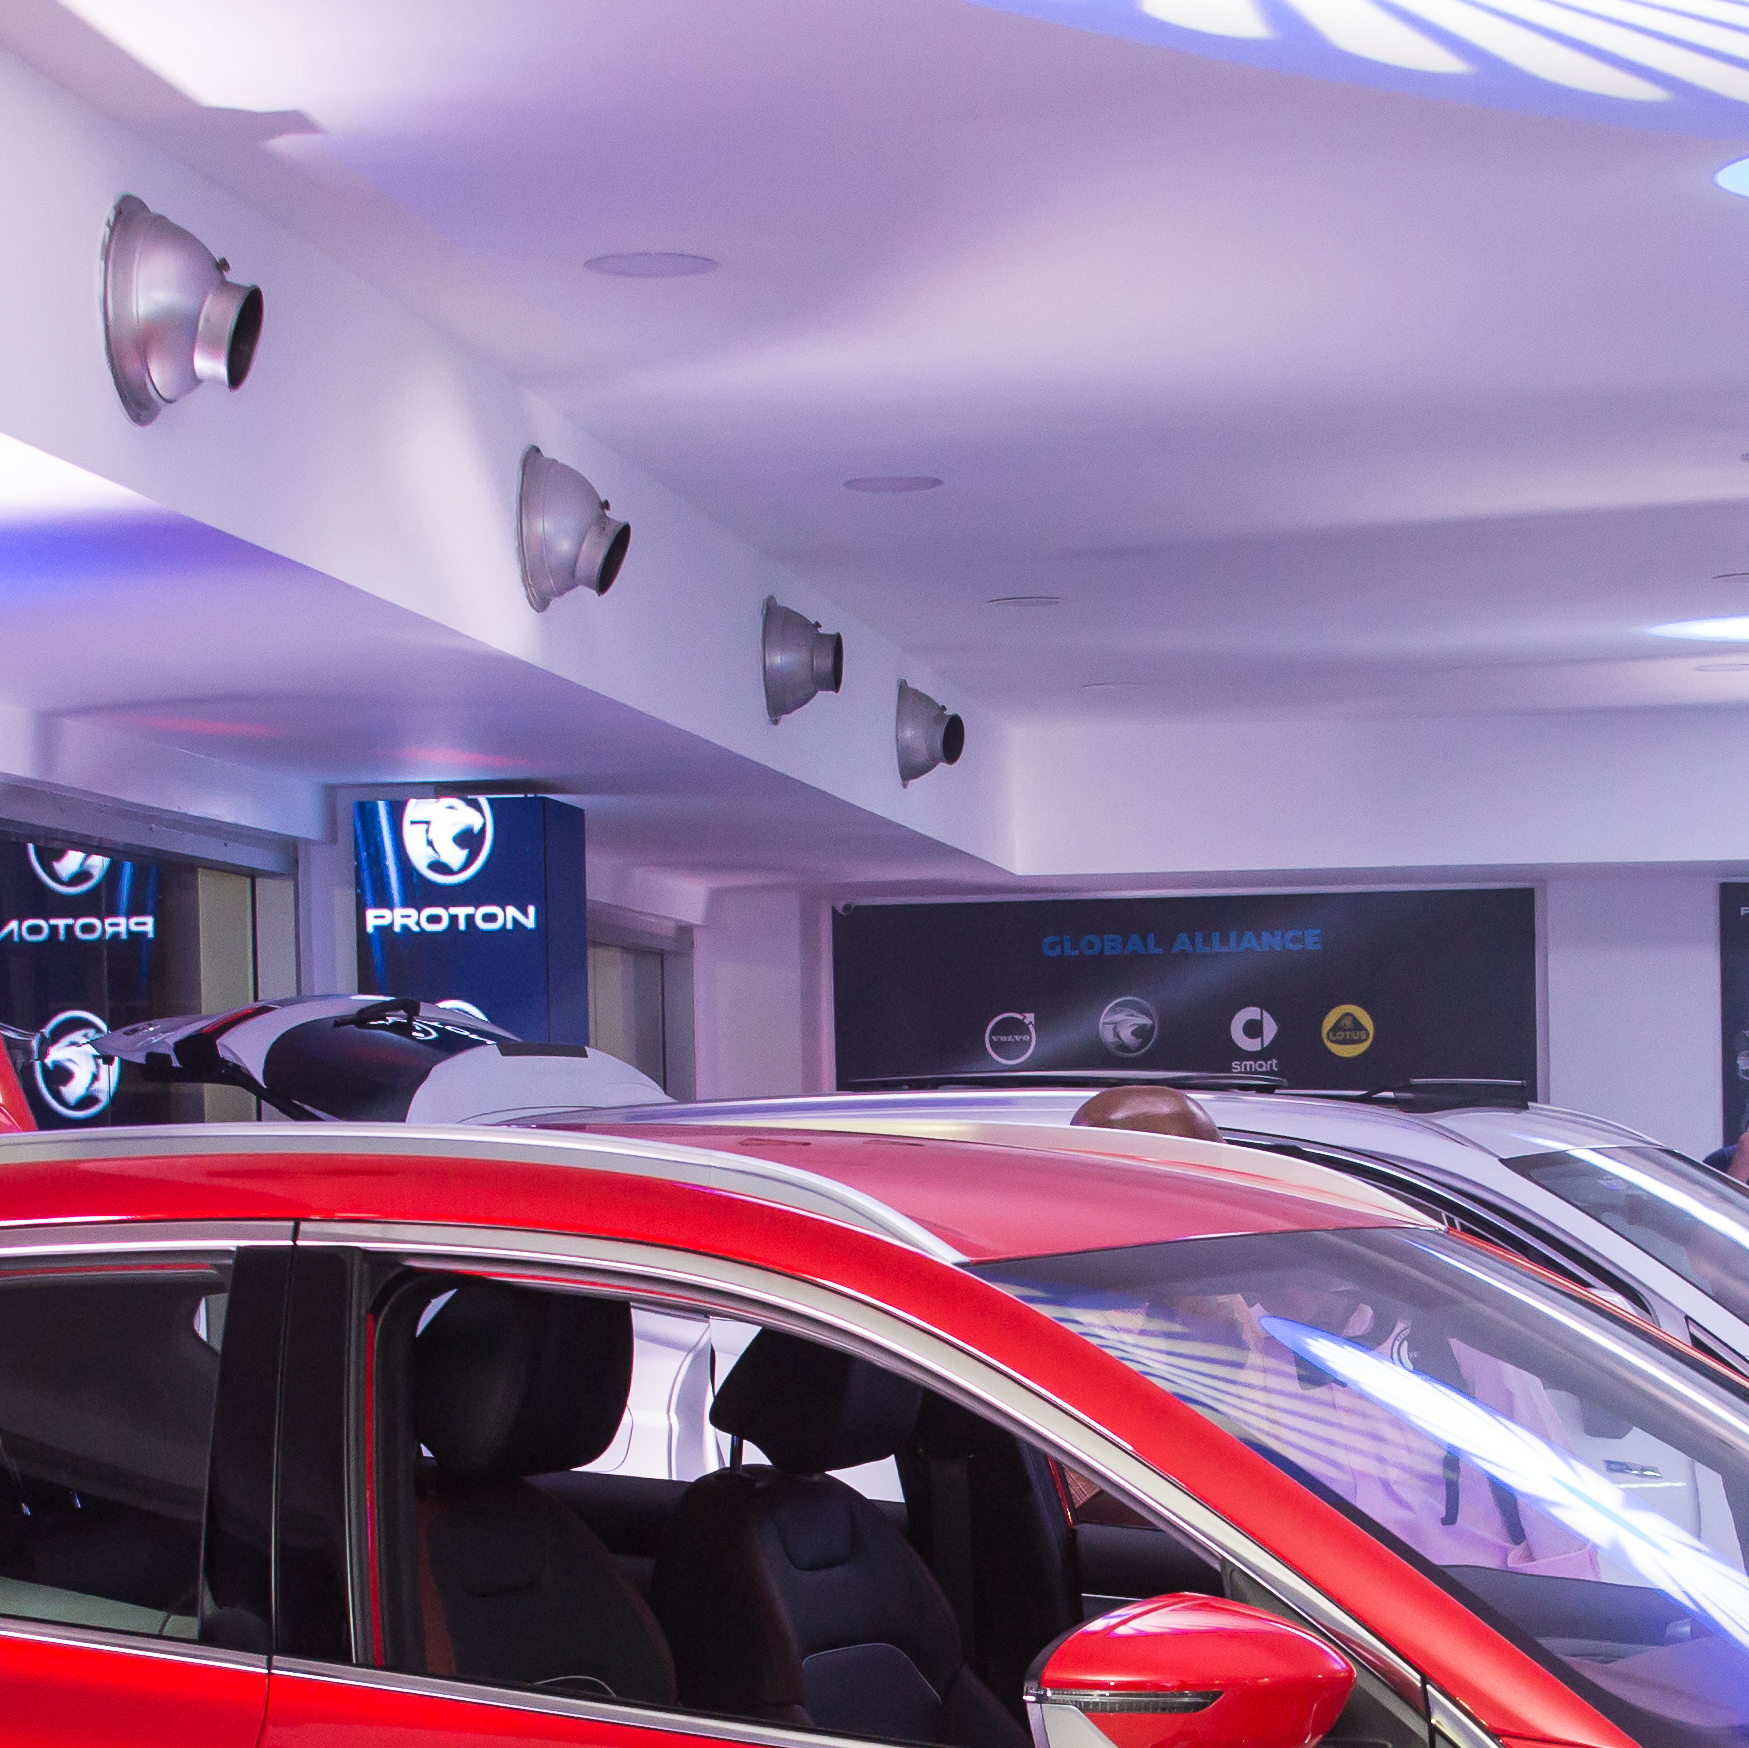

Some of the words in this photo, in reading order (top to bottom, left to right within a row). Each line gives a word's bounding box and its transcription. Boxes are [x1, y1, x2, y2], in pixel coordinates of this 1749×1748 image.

[365, 904, 537, 934] PROTON
[1042, 932, 1165, 957] GLOBAL
[1173, 929, 1323, 954] ALLIANCE
[991, 1034, 1031, 1043] VOLVO
[1329, 1030, 1368, 1041] LOTUS
[1231, 1058, 1279, 1074] smart
